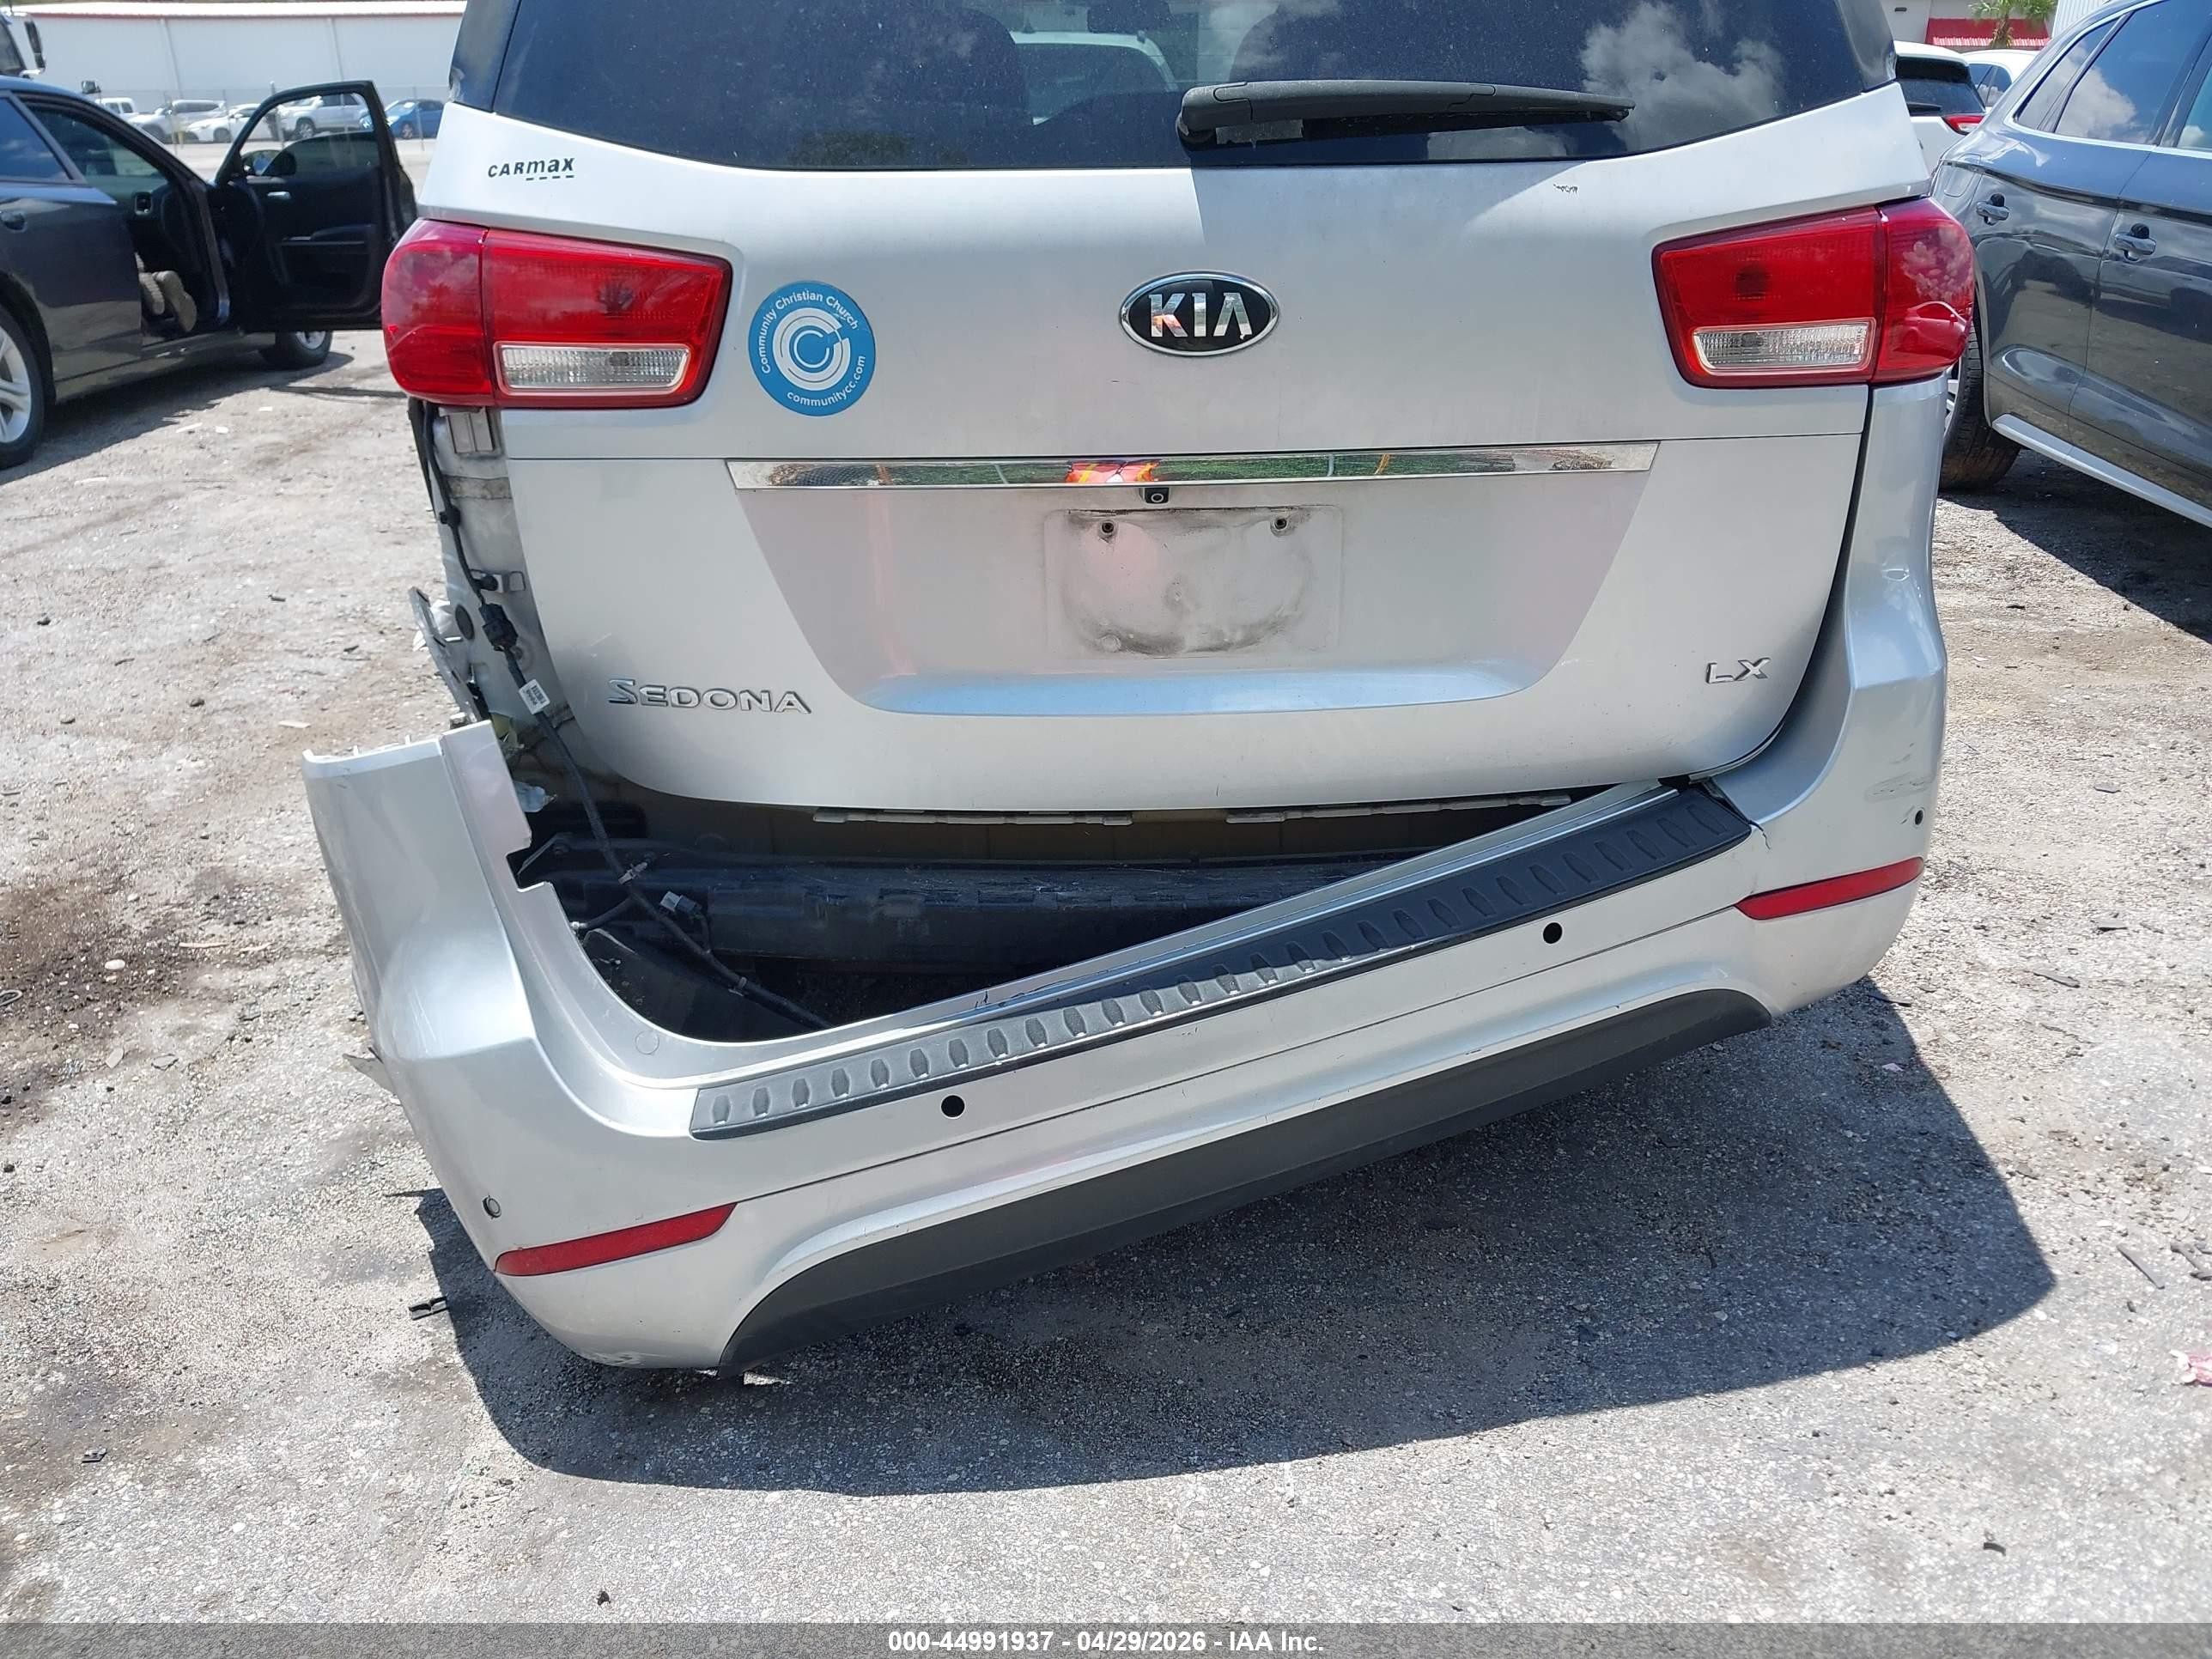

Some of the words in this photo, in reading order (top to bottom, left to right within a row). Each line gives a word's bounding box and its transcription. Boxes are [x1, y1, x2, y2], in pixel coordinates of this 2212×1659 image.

[758, 308, 777, 374] Community
[775, 289, 823, 310] Christian
[826, 295, 859, 330] Church
[1148, 292, 1254, 338] KIA
[787, 355, 866, 407] communitycc.com
[1705, 657, 1771, 684] LX
[608, 678, 812, 714] SEDONA
